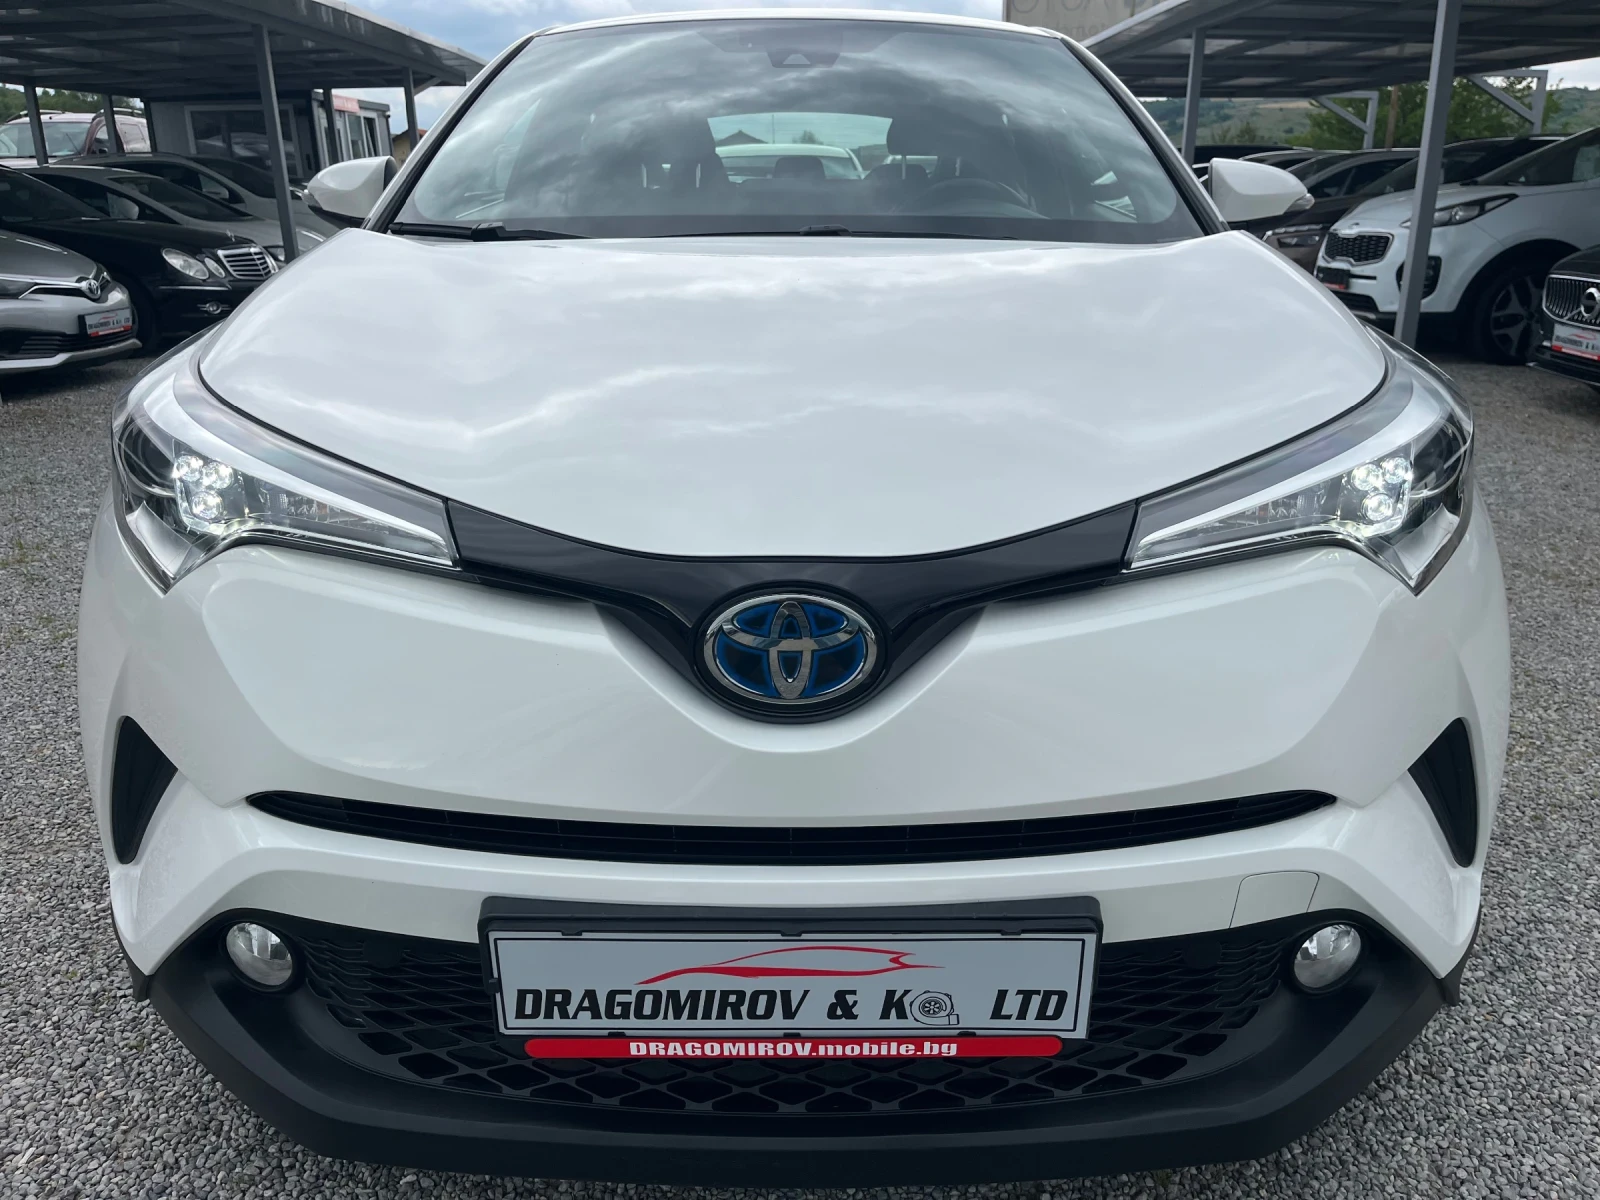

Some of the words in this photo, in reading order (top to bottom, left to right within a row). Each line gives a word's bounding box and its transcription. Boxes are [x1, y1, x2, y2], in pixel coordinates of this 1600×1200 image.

[514, 988, 811, 1020] DRAGOMIROV
[826, 989, 860, 1021] &
[989, 989, 1069, 1021] LTD
[629, 1041, 958, 1057] DRAGOMIROV.mobile.bg
